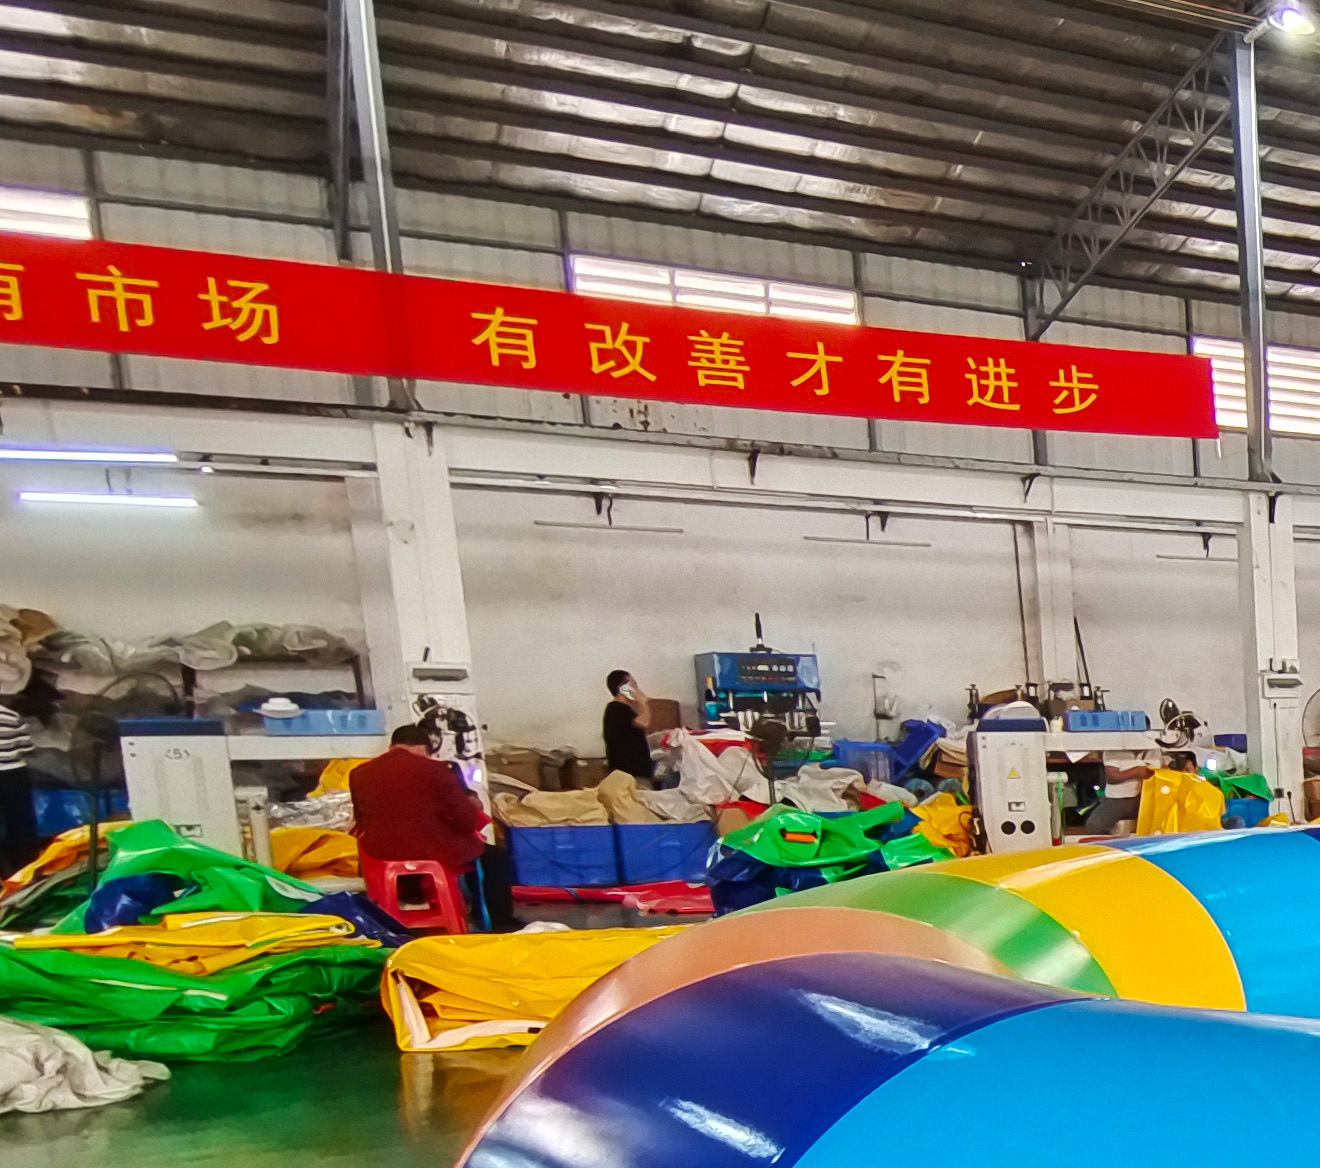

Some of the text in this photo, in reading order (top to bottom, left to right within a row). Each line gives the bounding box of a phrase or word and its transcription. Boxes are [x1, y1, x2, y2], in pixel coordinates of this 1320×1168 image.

[471, 306, 1099, 415] 有改善才有进步
